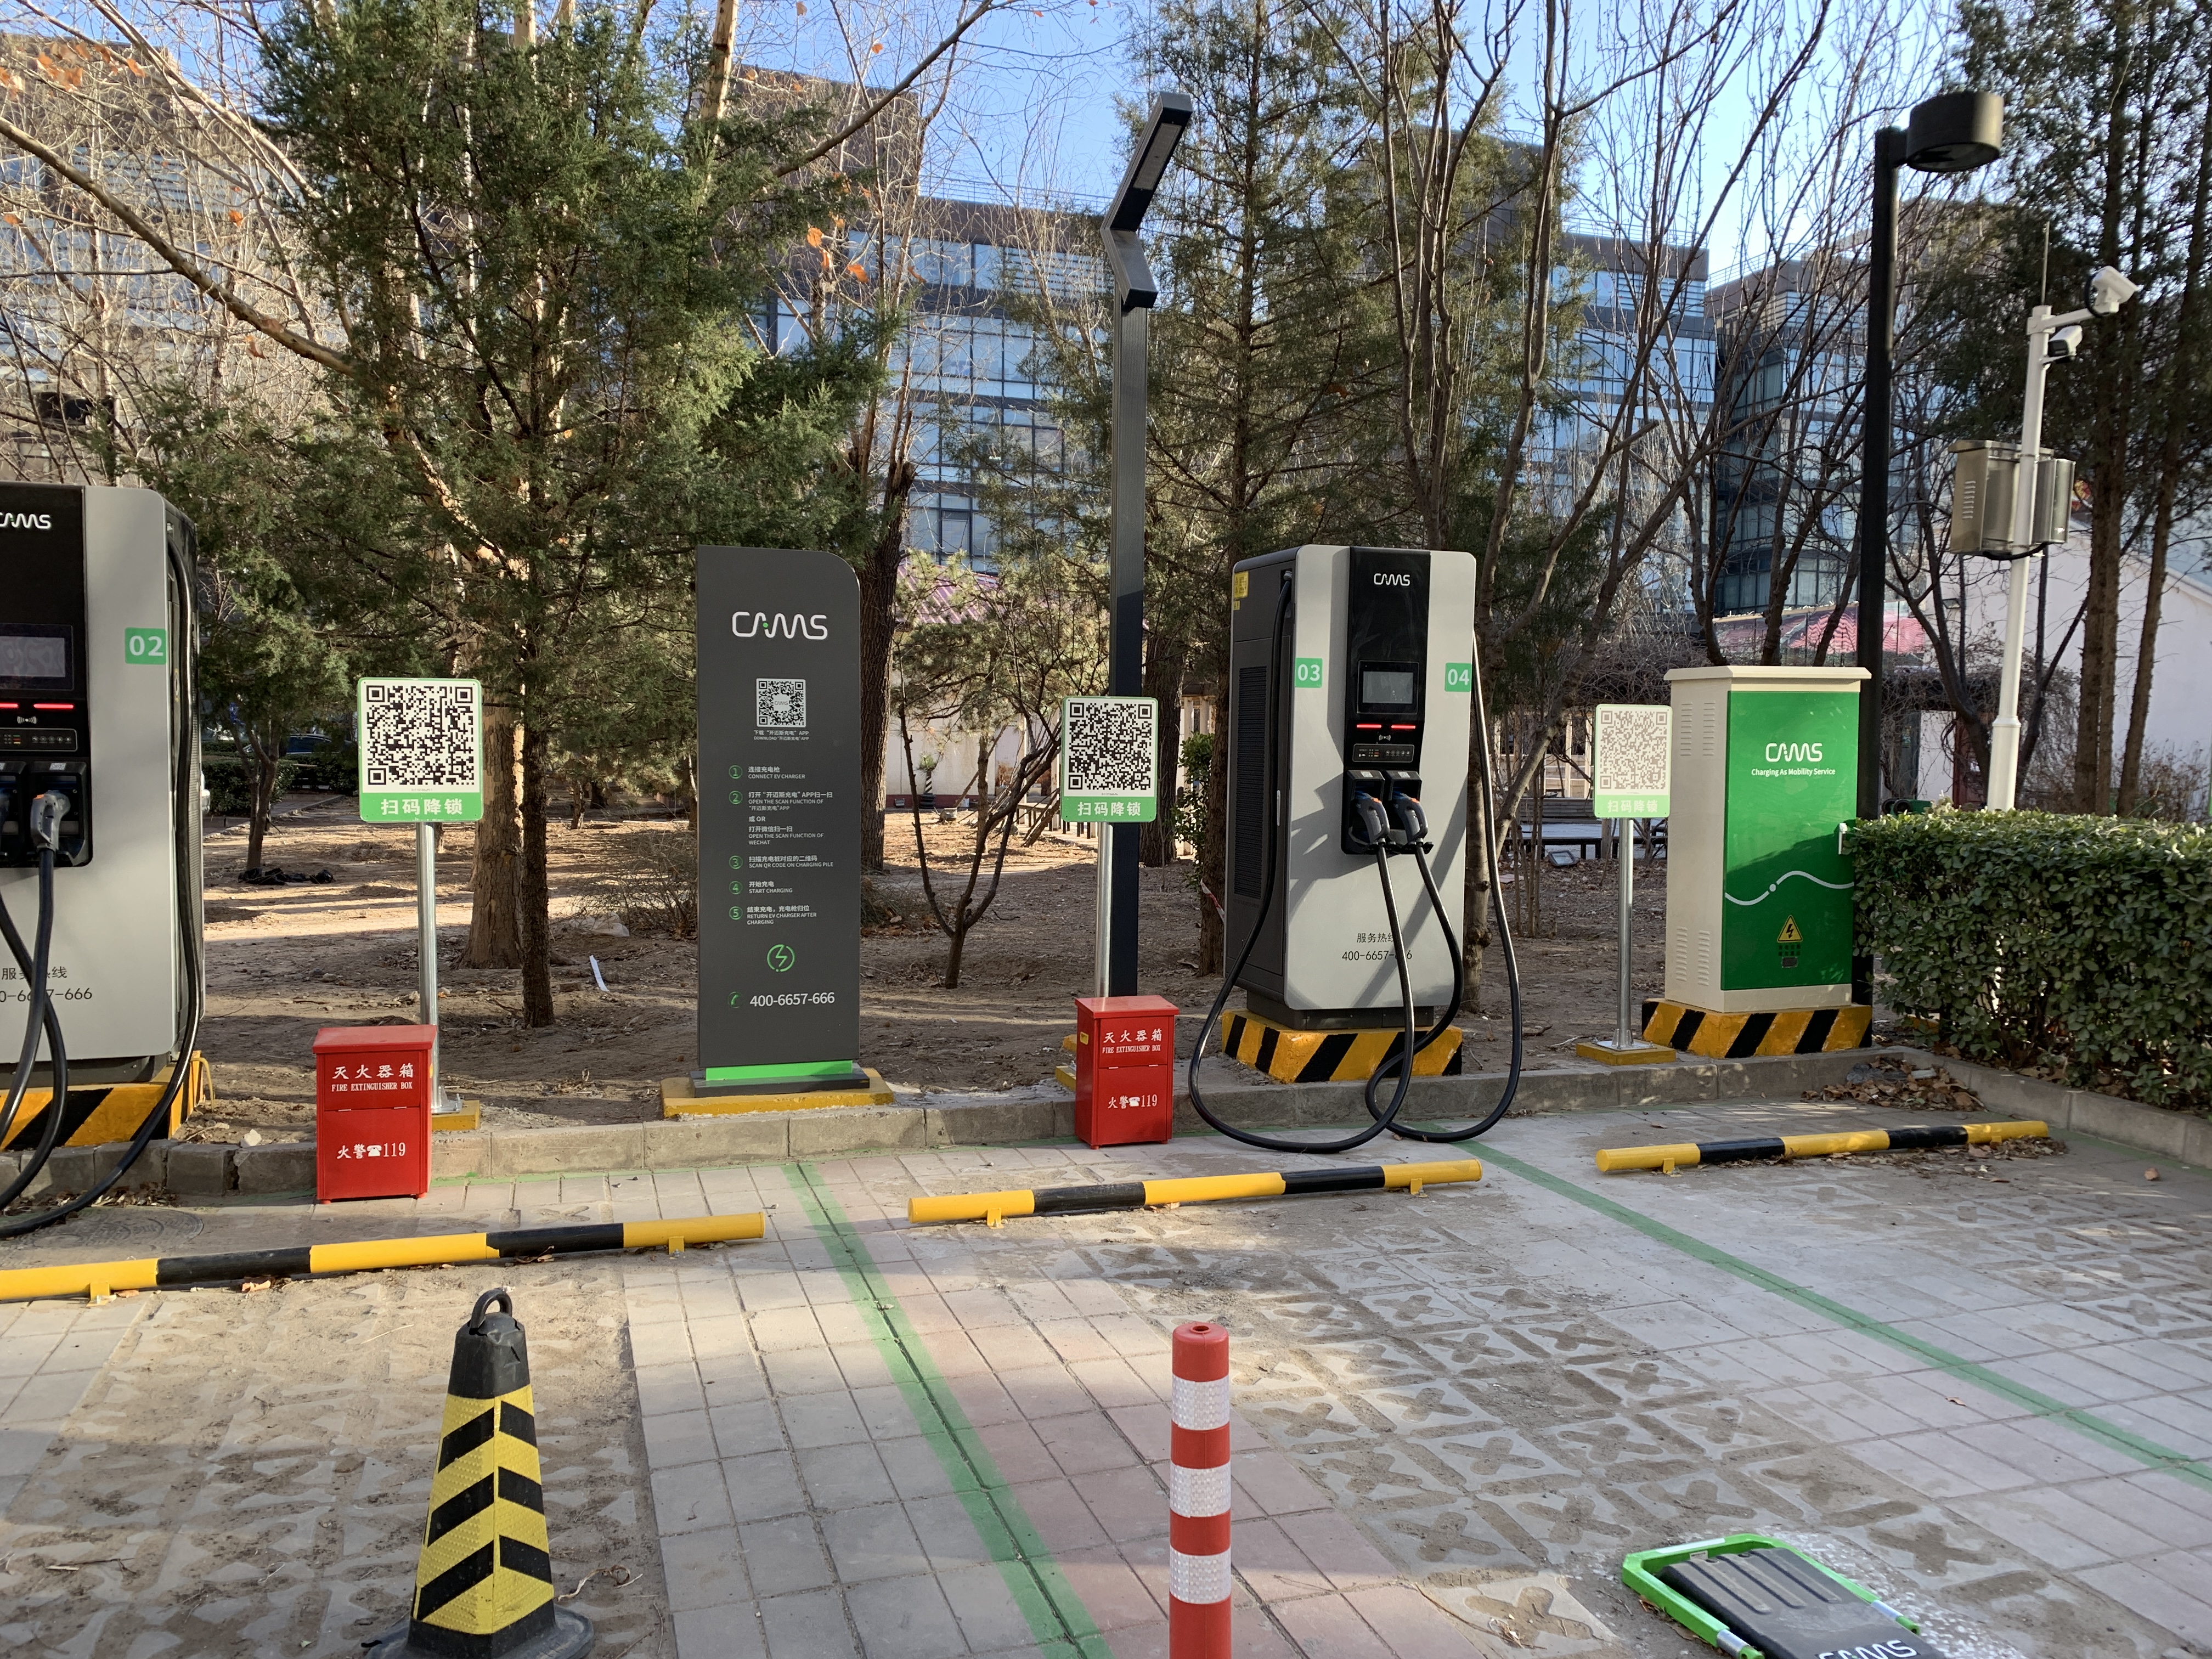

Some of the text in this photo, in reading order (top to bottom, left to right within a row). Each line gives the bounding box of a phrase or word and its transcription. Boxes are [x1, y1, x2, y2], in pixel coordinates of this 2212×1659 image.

[1374, 573, 1410, 586] CAMS
[732, 611, 828, 640] CAMS
[129, 635, 164, 656] 02
[1297, 664, 1320, 681] 03
[1448, 669, 1470, 685] 04
[1766, 743, 1822, 762] CAMS
[1788, 768, 1813, 776] Mobility
[381, 798, 462, 815] 扫码降锁
[1077, 802, 1141, 816] 扫码降锁
[1607, 800, 1658, 813] 扫码降锁
[1342, 950, 1413, 961] 400-6657-6
[2, 966, 67, 980] 服线
[749, 992, 835, 1007] 400-6657-666
[1103, 1028, 1162, 1043] 灭火器箱
[1116, 1045, 1150, 1053] EXTINGUISHER
[332, 1062, 414, 1080] 灭火器箱
[331, 1081, 413, 1092] FIRE EXTINGUISHER BOX
[1141, 1094, 1158, 1107] 119
[383, 1142, 406, 1158] 119
